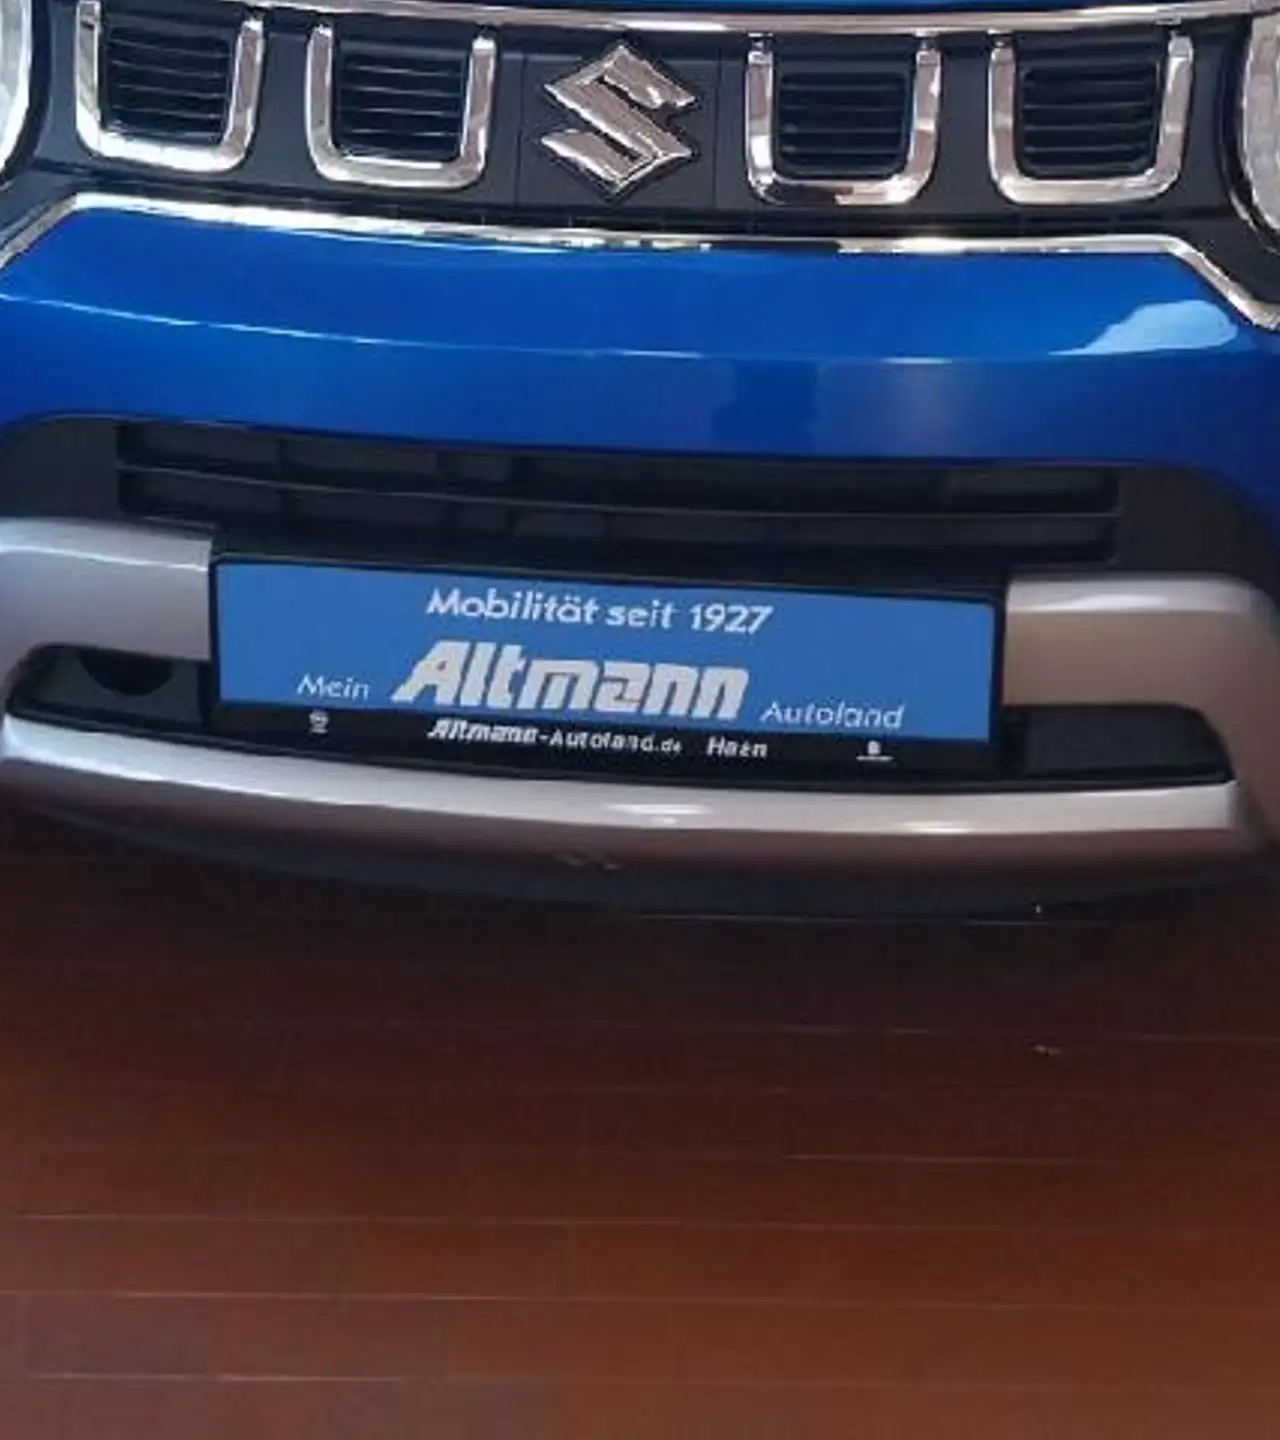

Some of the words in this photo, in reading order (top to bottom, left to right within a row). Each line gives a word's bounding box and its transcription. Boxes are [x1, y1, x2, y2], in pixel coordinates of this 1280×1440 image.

[426, 587, 599, 625] Mobilität
[605, 599, 675, 629] seit
[689, 602, 775, 636] 1927
[296, 673, 371, 701] Mein
[390, 639, 749, 721] Altmann
[758, 700, 906, 730] Autoland
